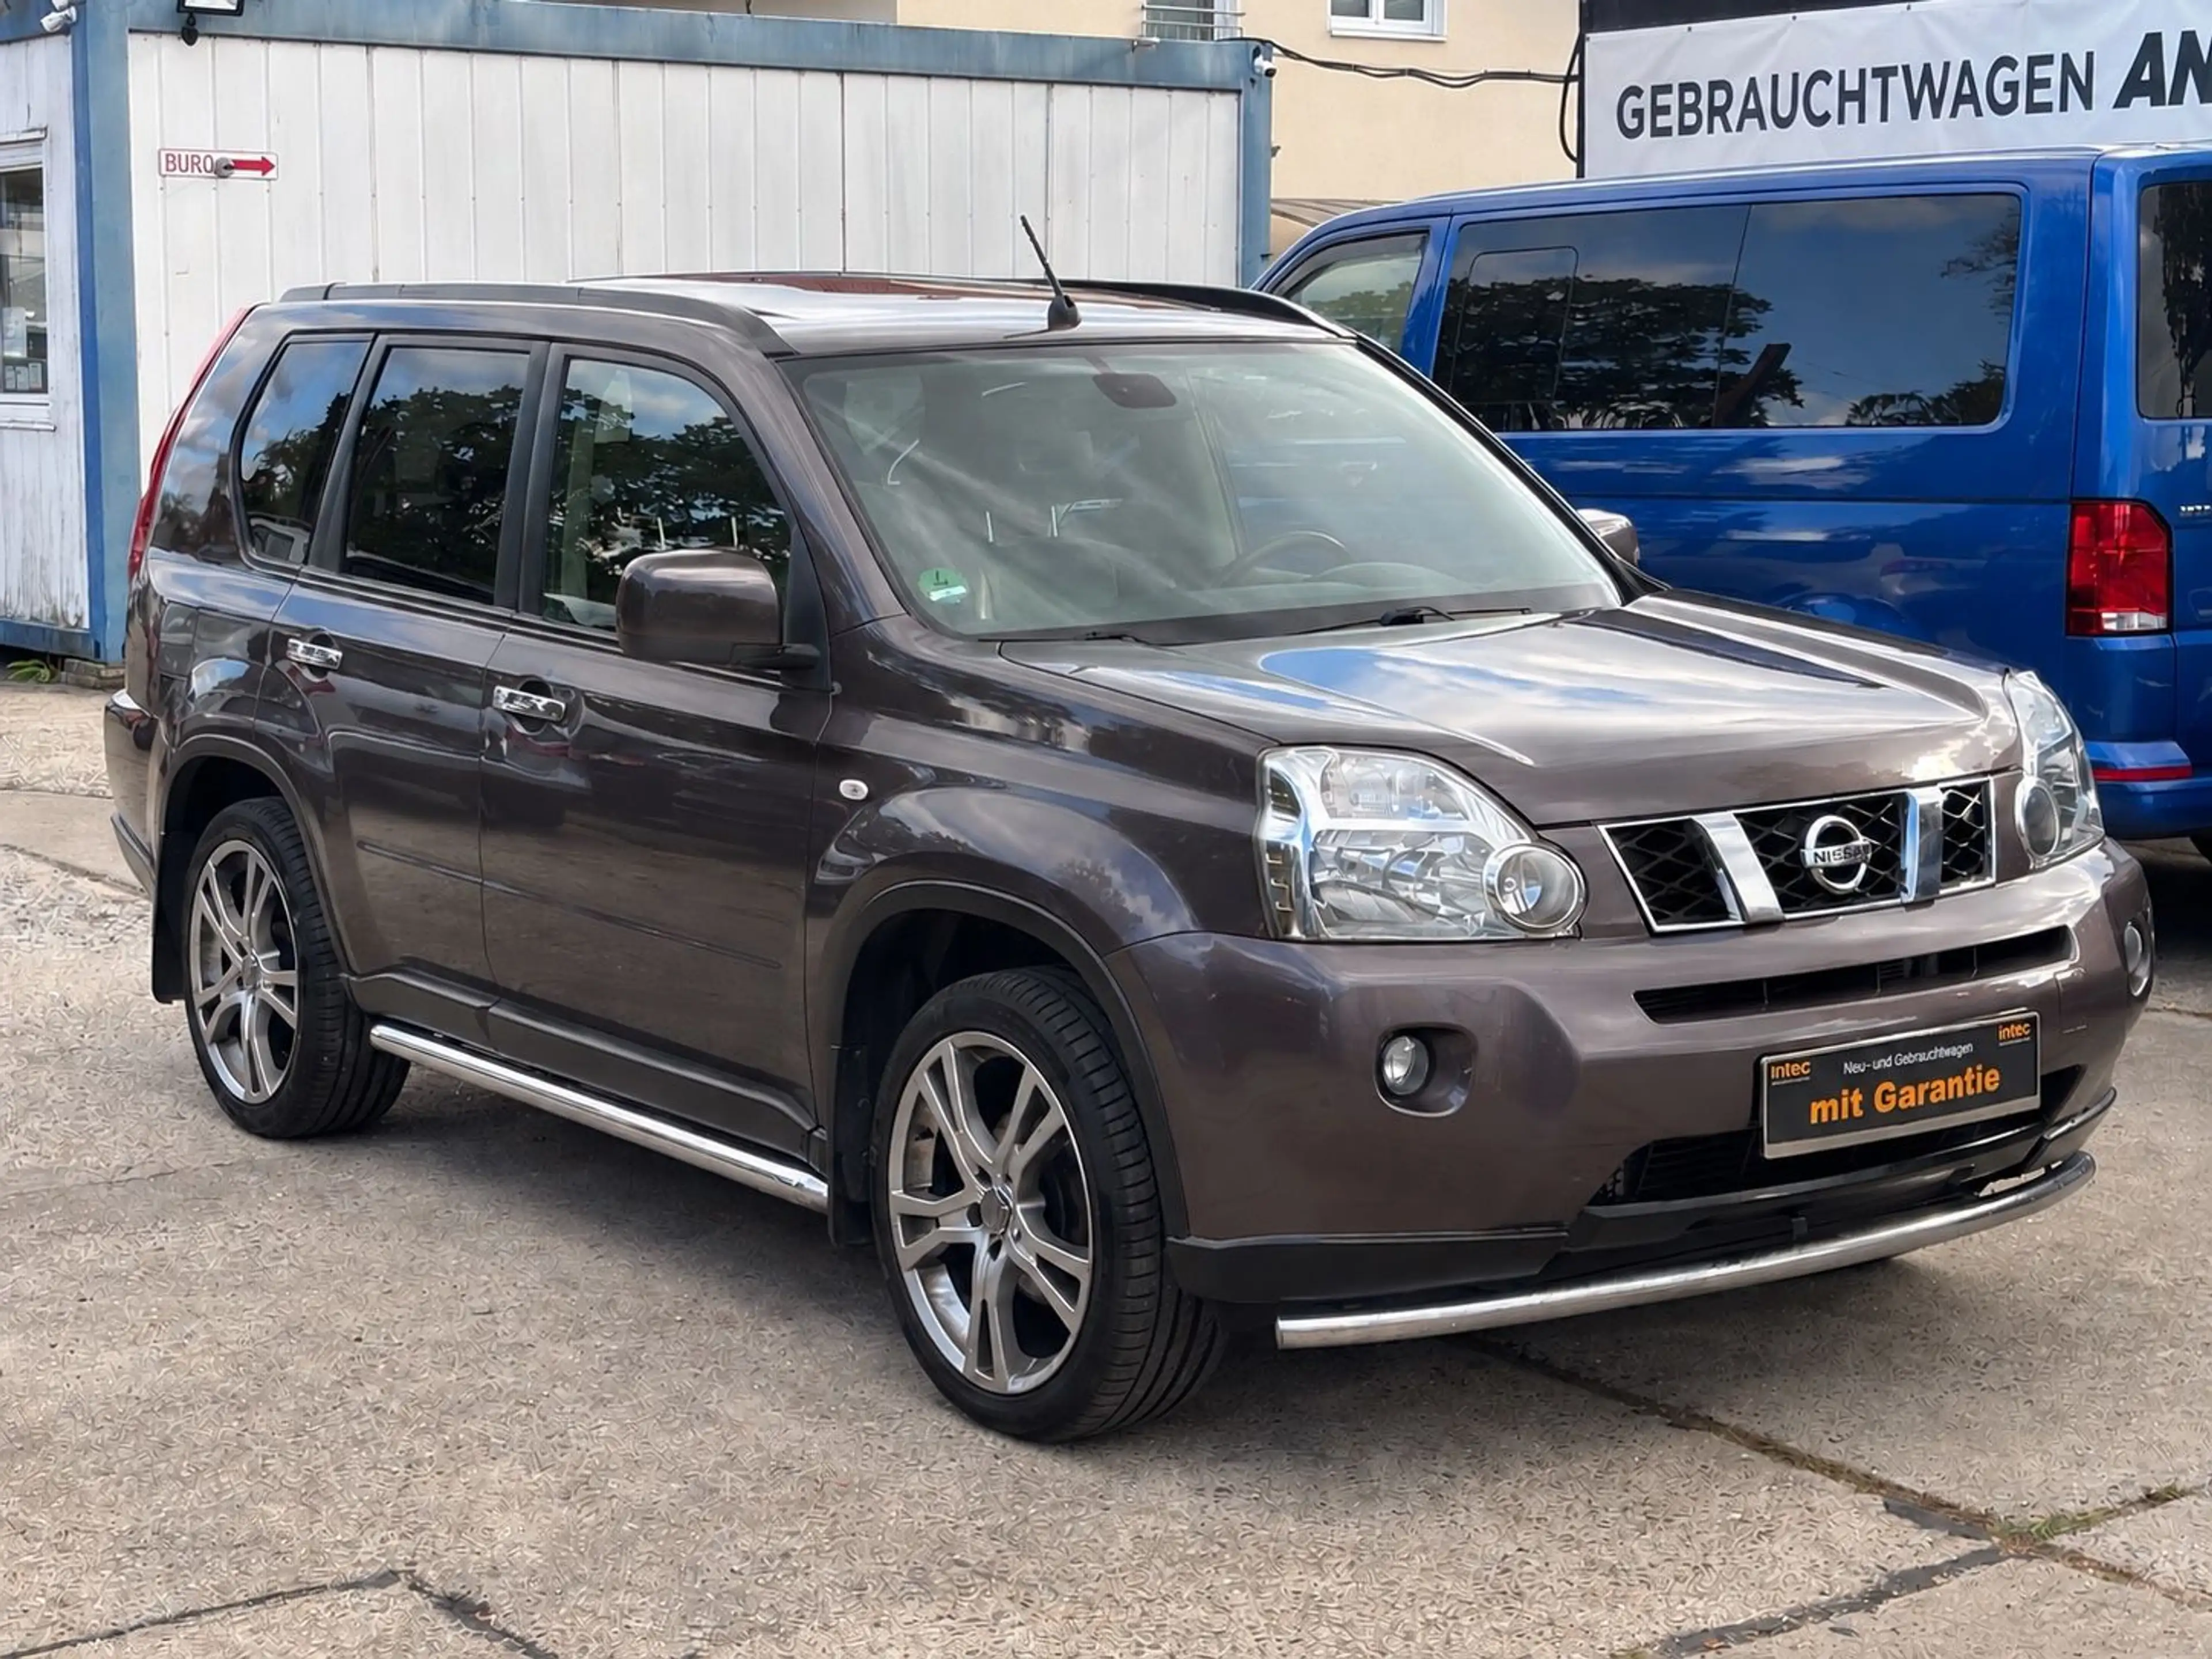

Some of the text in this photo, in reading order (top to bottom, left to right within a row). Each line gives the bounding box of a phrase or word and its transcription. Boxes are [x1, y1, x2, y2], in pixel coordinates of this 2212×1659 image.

[1616, 51, 2094, 139] GEBRAUCHTWAGEN
[1895, 1043, 1974, 1066] Gebrauchtwagen
[1810, 1065, 2001, 1124] mit Garantie
